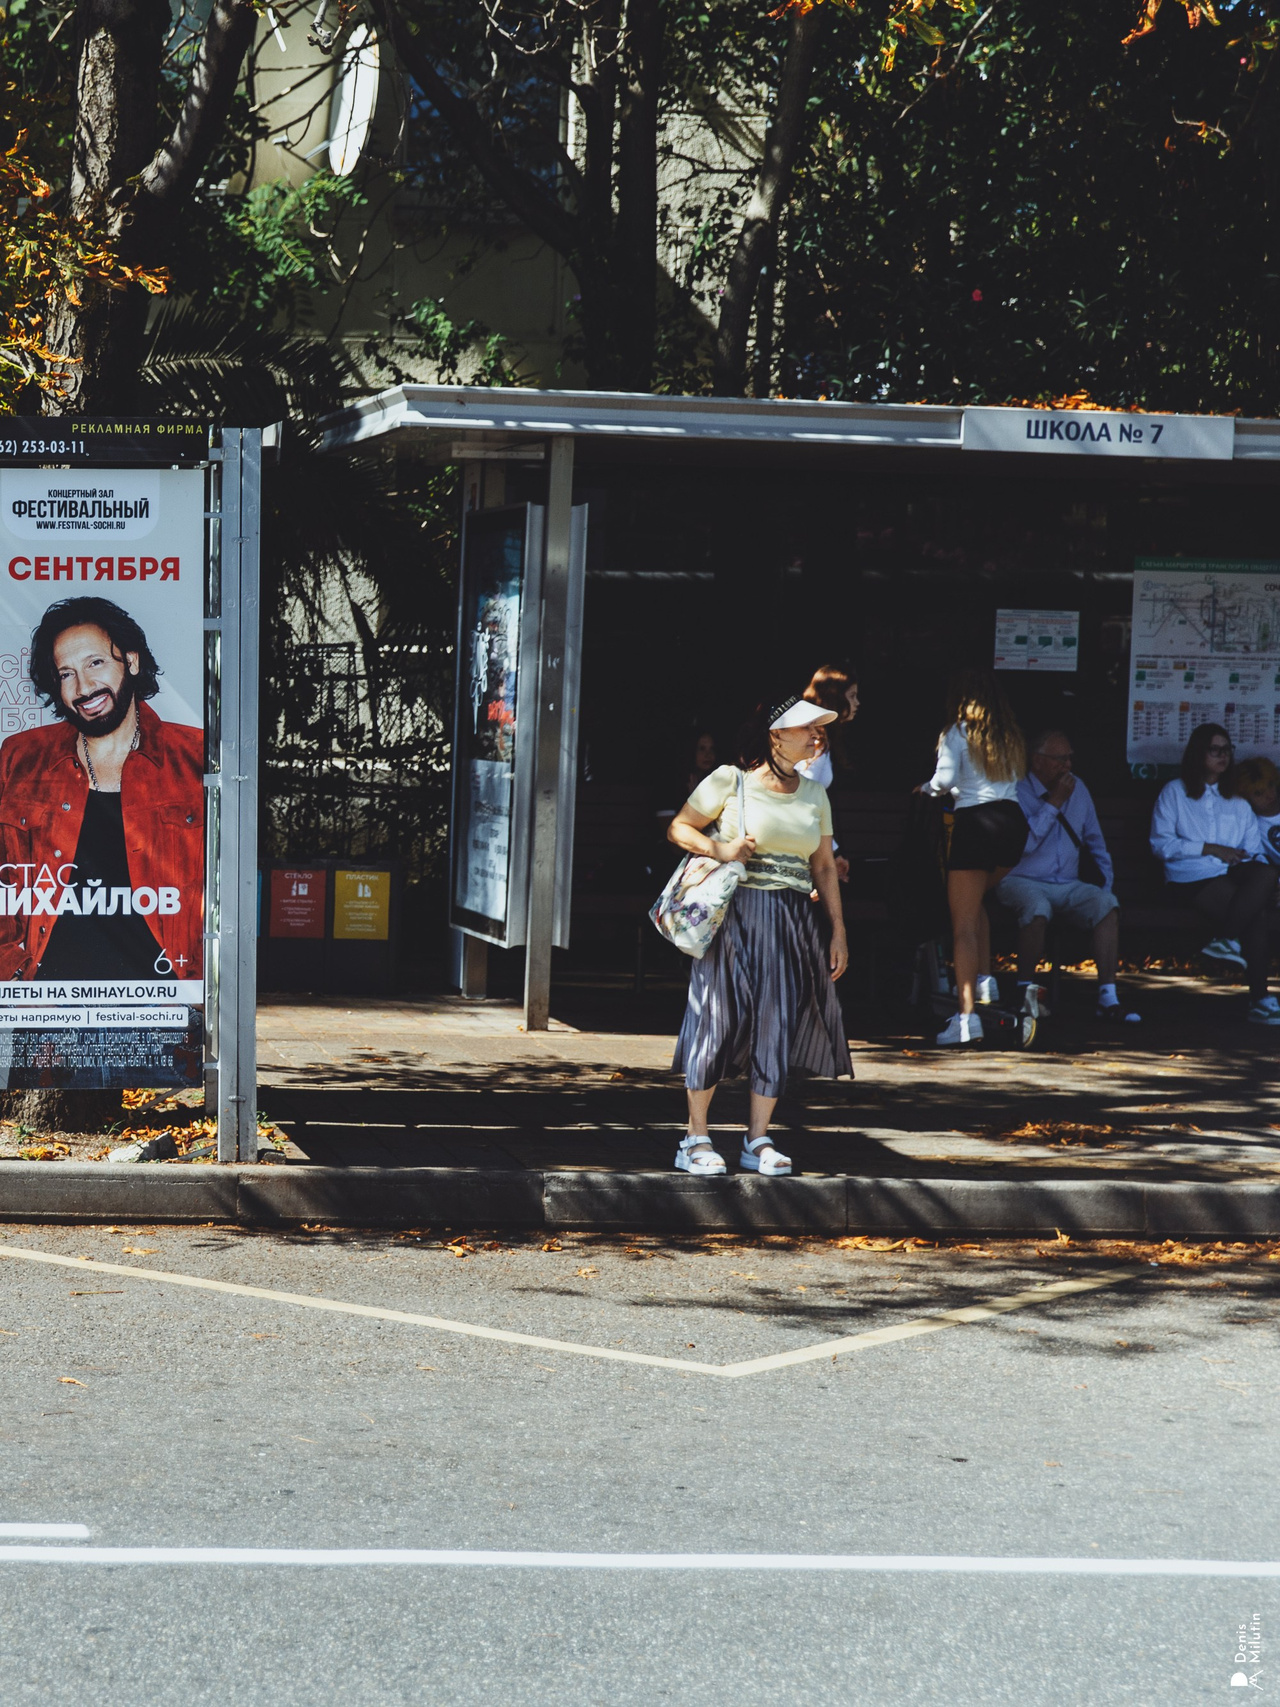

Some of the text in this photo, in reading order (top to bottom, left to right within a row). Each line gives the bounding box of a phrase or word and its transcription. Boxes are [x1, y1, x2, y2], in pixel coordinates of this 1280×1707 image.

[71, 423, 205, 436] РЕКЛАМНАЯ ФИРМА
[1025, 418, 1165, 445] ШКОЛА № 7
[22, 440, 86, 454] 253-03-11
[47, 488, 114, 498] КОНЦЕРТНЫЙ ЗАЛ
[11, 497, 150, 519] ФЕСТИВАЛЬНЫЙ
[35, 520, 127, 531] WWW.FESTIVAL-SOCHI.RU
[7, 556, 181, 581] СЕНТЯБРЯ
[284, 872, 313, 880] СТЕКЛО
[345, 873, 380, 881] ПЛАСТИК
[153, 948, 189, 975] 6+
[46, 986, 68, 999] НА
[70, 986, 178, 999] SMIHAYLOV.RU
[21, 1013, 82, 1025] напрямую
[95, 1010, 184, 1022] festival-sochi.ru
